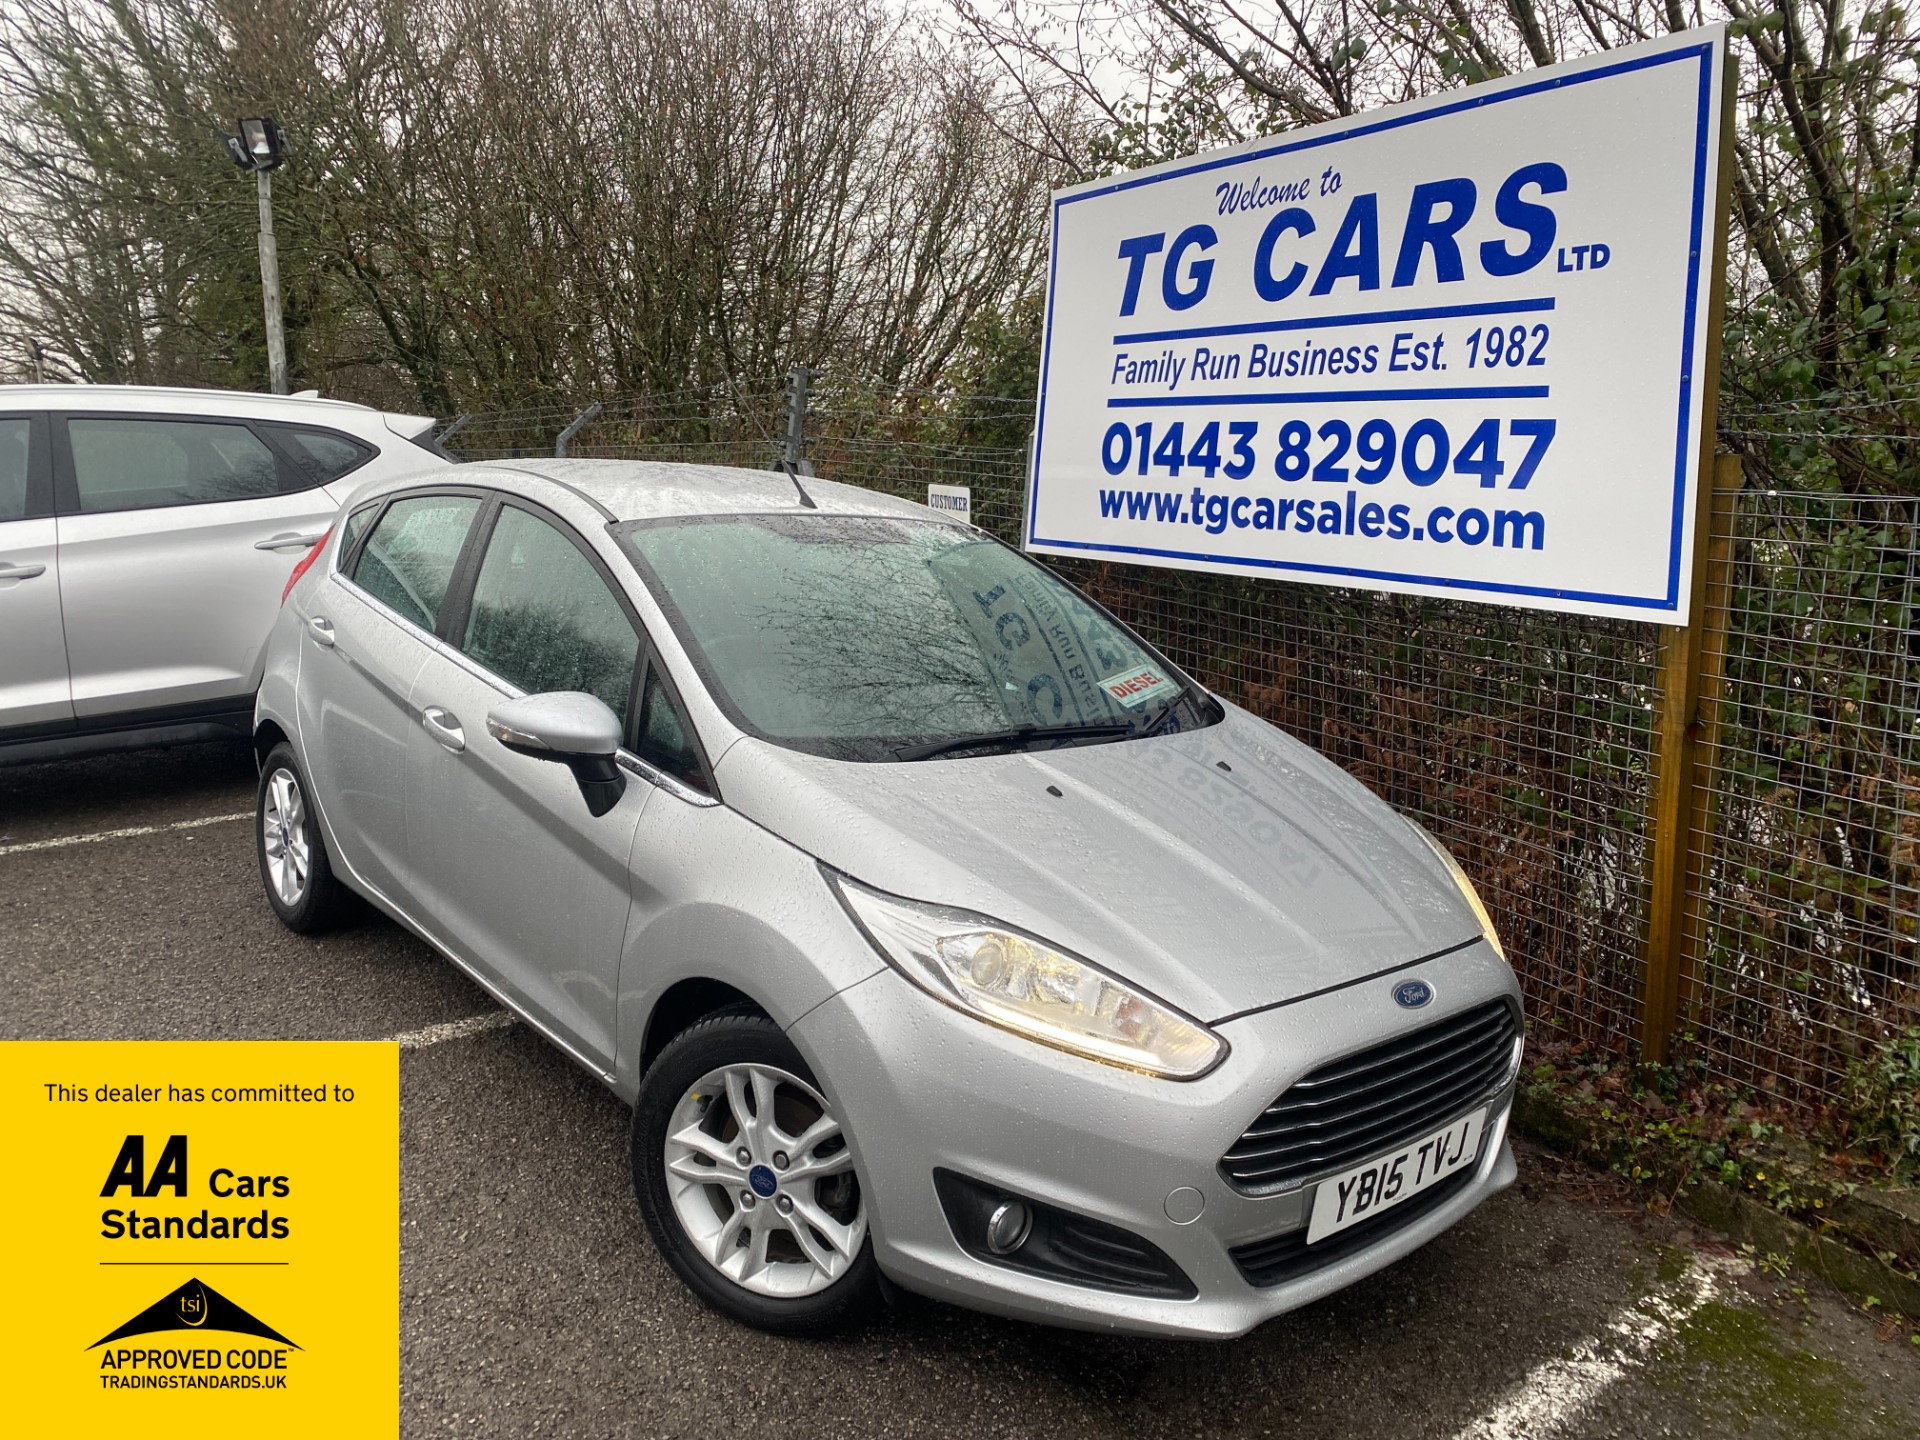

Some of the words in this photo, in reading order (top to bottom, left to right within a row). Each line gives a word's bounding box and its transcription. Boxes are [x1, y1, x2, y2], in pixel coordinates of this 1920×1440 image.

[1216, 176, 1311, 216] Welcome
[1319, 166, 1342, 196] to
[1118, 224, 1218, 316] TG
[1253, 162, 1568, 303] CARS
[1557, 243, 1611, 273] LTD
[1111, 351, 1187, 391] Family
[1191, 345, 1241, 383] Run
[1247, 342, 1379, 379] Business
[1388, 332, 1449, 373] Est.
[1466, 323, 1551, 370] 1982
[1101, 420, 1257, 478] 01443
[1274, 417, 1557, 490] 829047
[930, 494, 968, 512] CUSTOMER
[1099, 488, 1545, 551] www.tgcarsales.com
[1108, 671, 1164, 699] DIESEL
[1402, 985, 1426, 1004] Ford
[1335, 1158, 1408, 1223] YB15
[1415, 1121, 1470, 1187] TVJ
